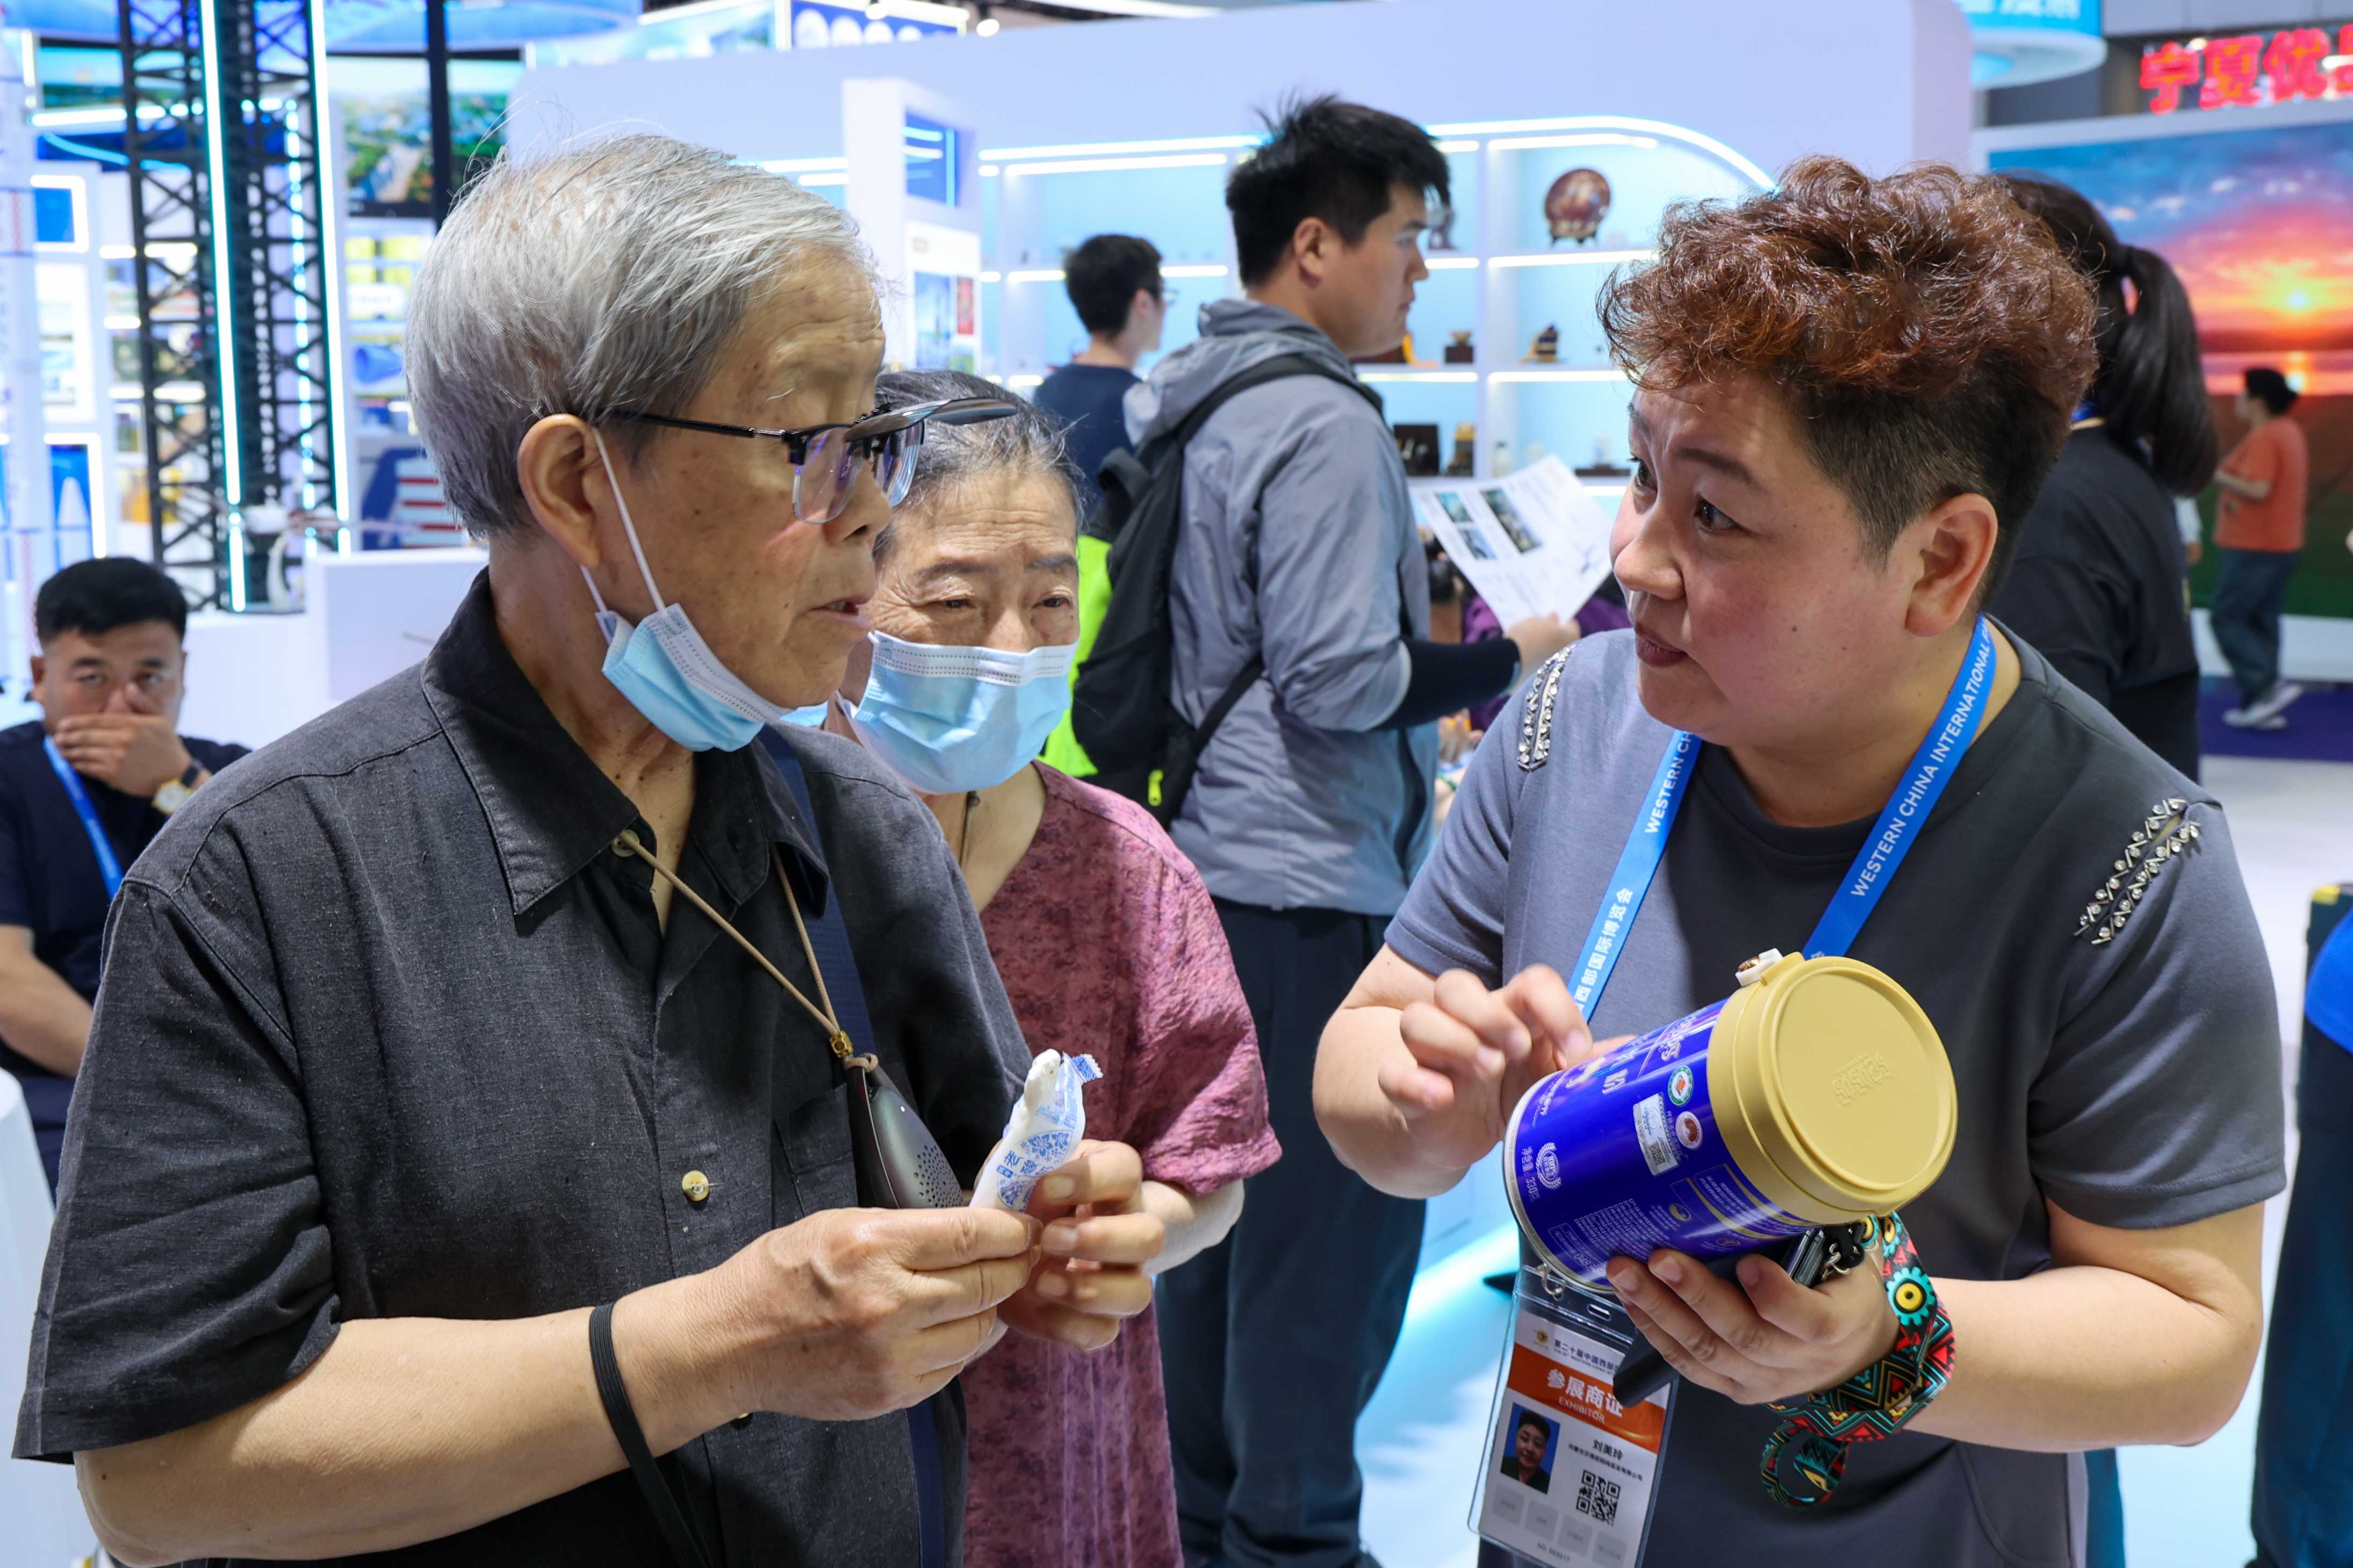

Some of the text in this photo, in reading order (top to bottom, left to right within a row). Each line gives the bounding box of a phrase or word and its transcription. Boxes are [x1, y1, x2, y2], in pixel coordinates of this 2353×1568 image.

[1644, 756, 1684, 833] WESTERN
[1851, 642, 1990, 897] WESTERN CHINA INTERNATIONAL
[1546, 1368, 1624, 1418] 参展商证
[1559, 1397, 1605, 1424] EXHIBITOR
